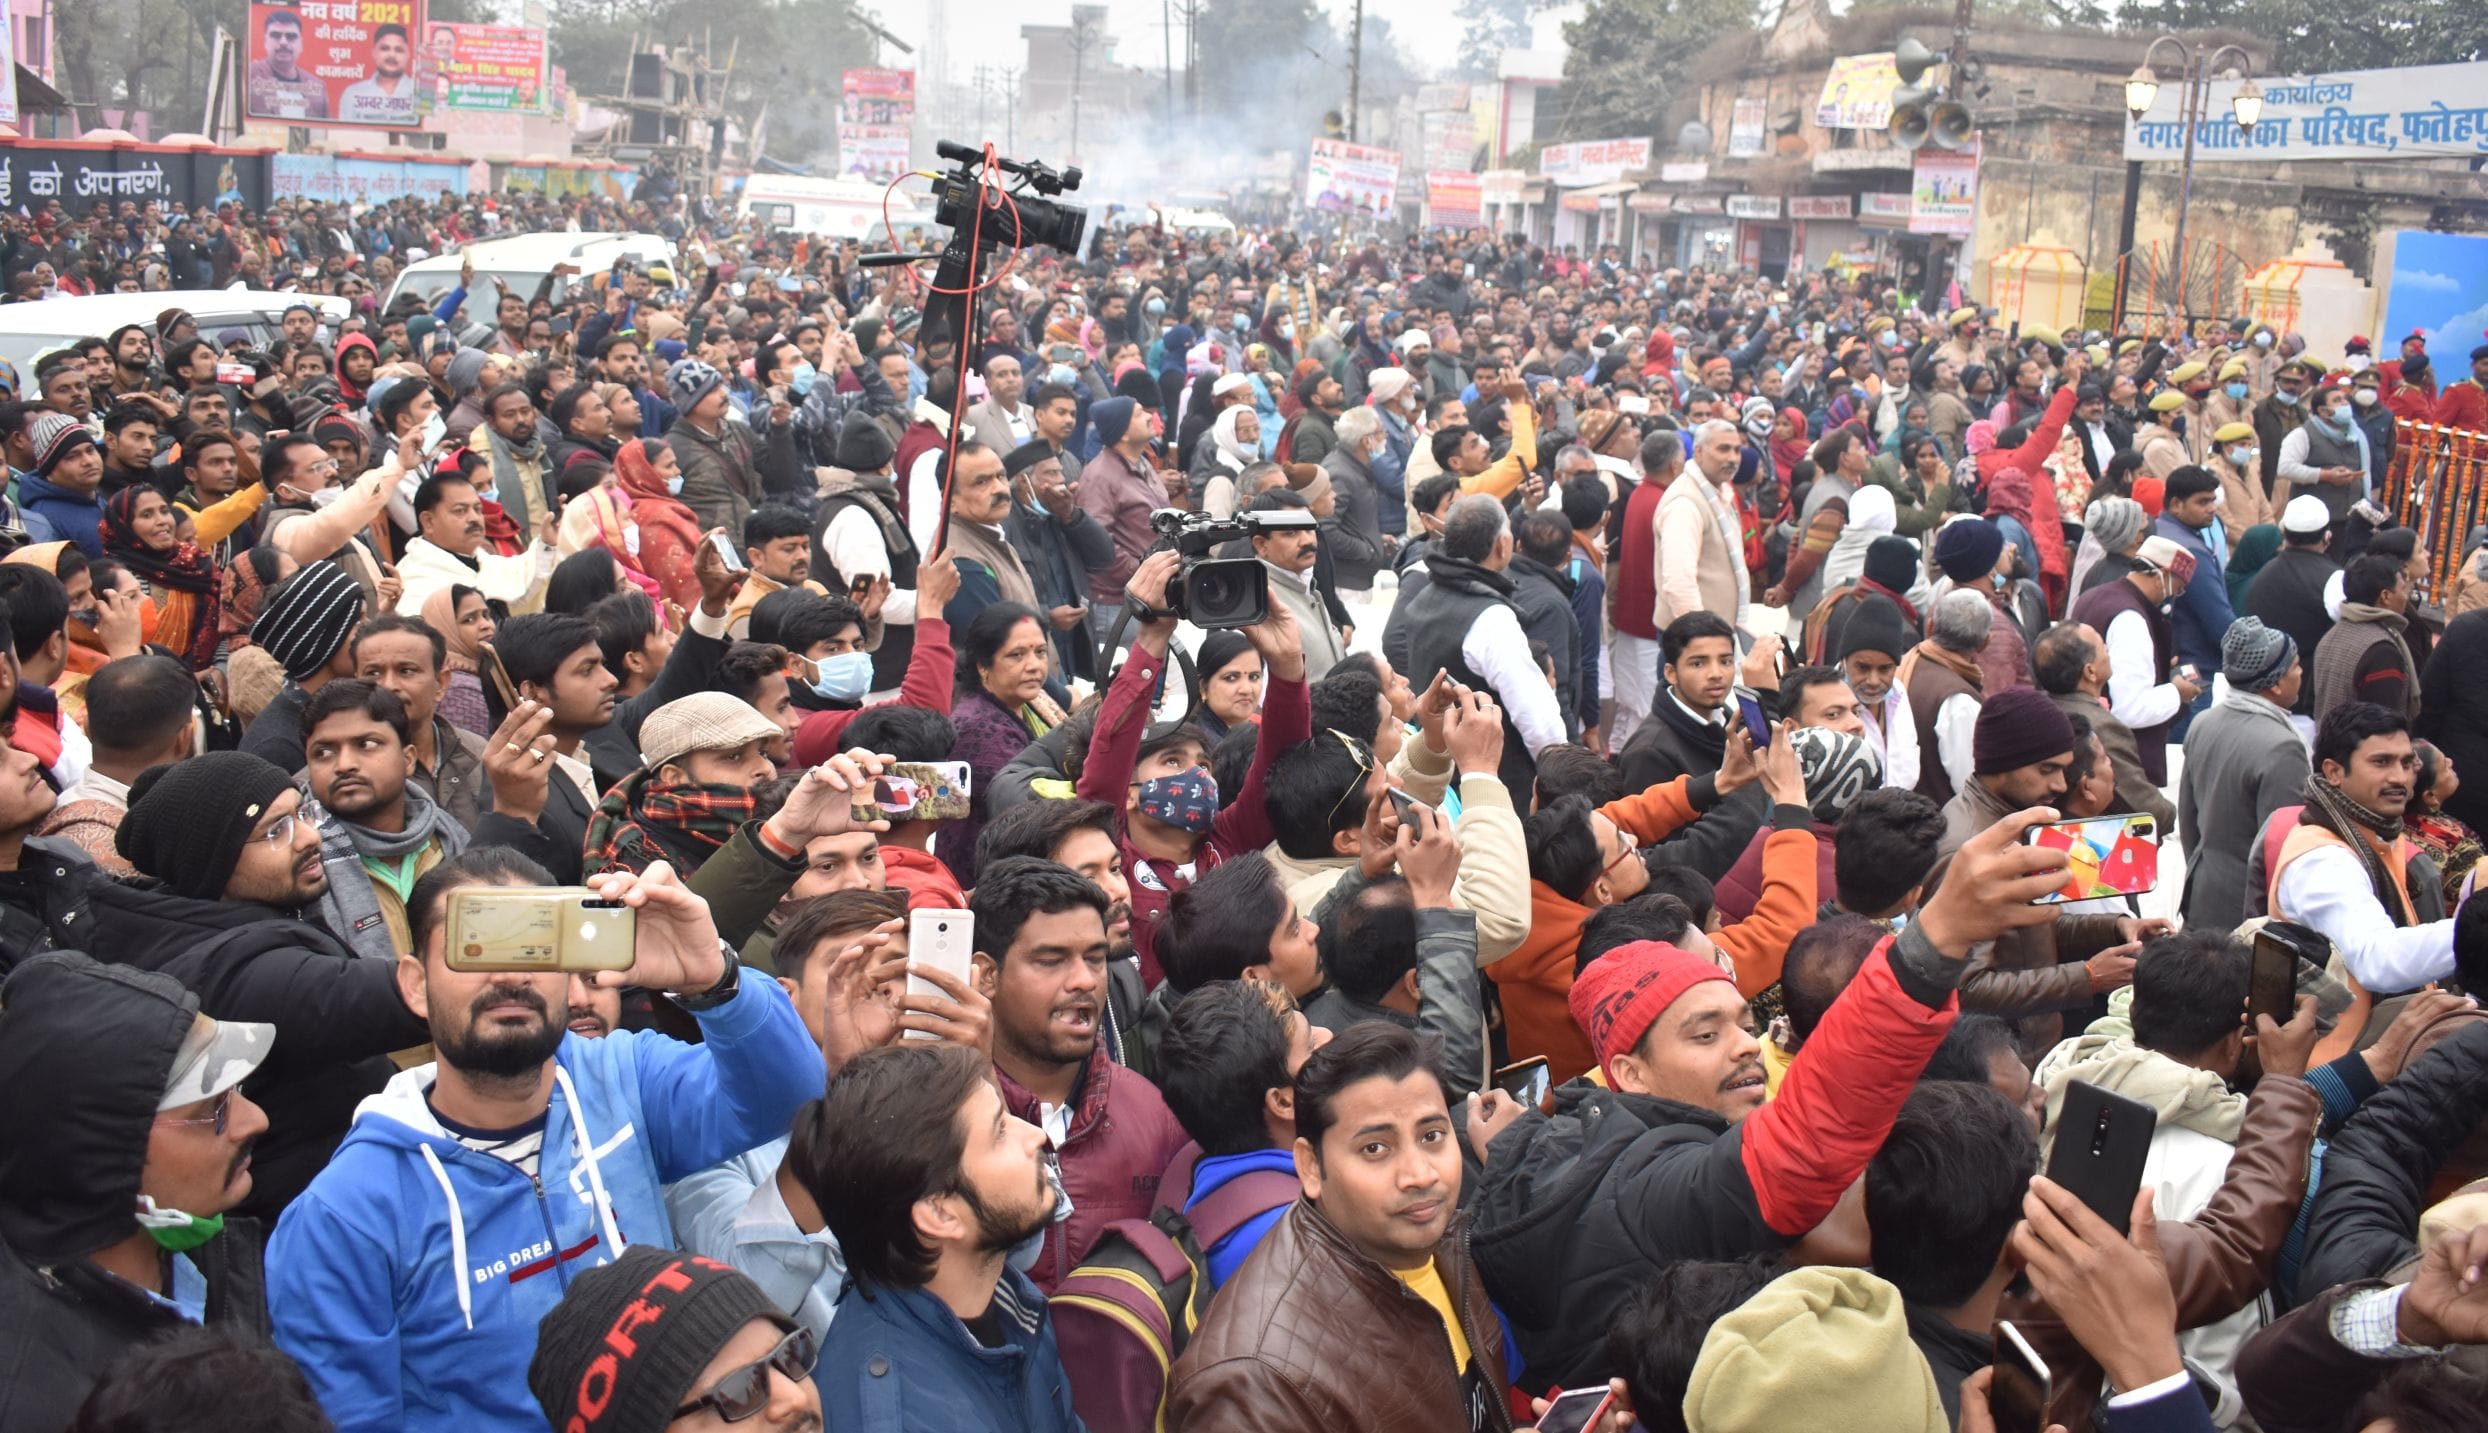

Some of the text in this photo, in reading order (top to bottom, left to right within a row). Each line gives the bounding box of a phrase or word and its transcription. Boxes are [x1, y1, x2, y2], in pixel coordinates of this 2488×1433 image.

[300, 0, 411, 24] नव वर्ष 2021
[315, 24, 368, 42] की हार्दिक
[2265, 77, 2355, 105] कार्यालय
[2140, 121, 2187, 149] नगर
[2196, 111, 2292, 149] पालिका
[2302, 107, 2399, 151] परिषद,
[29, 160, 63, 196] को
[474, 1260, 507, 1283] BIG
